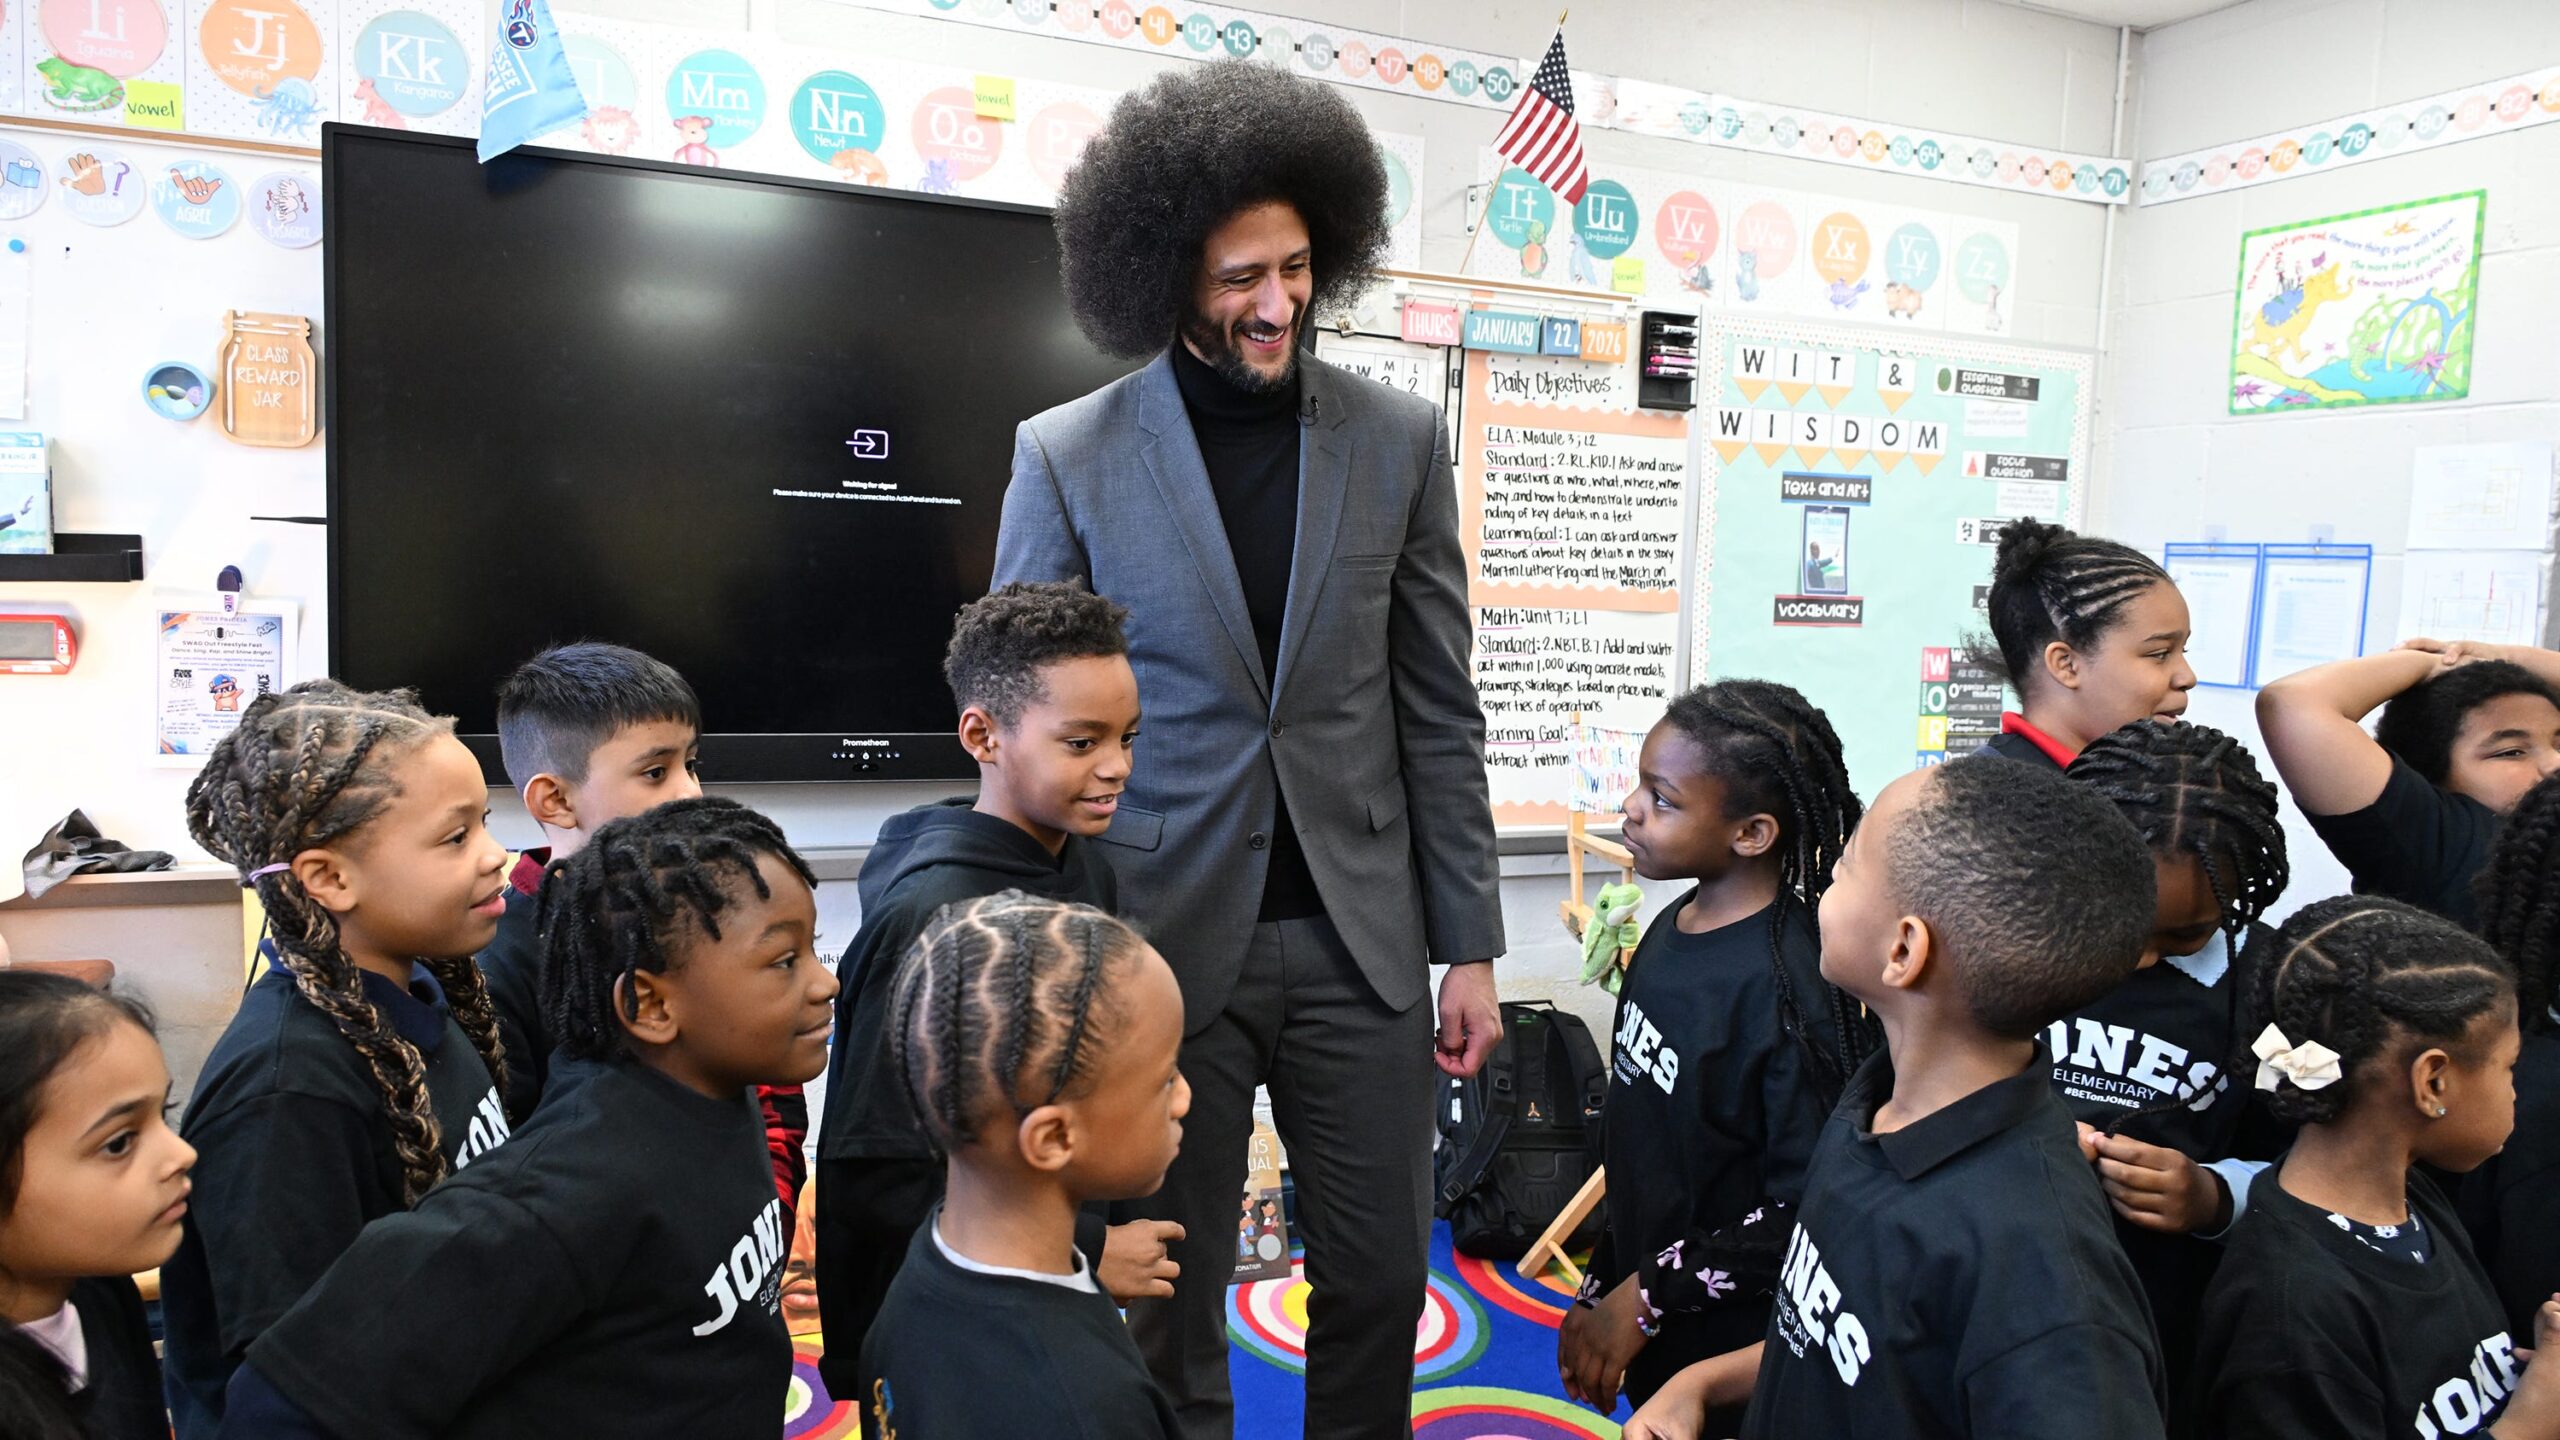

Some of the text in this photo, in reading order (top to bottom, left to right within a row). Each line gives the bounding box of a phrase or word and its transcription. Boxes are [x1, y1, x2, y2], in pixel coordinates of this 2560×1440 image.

[1106, 10, 1132, 31] 40
[1148, 16, 1167, 38] 41
[233, 11, 287, 71] Jj
[1187, 22, 1212, 46] 42
[1231, 28, 1251, 49] 43
[378, 33, 441, 84] Kk
[1305, 40, 1330, 63] 45
[1343, 47, 1367, 70] 46
[1379, 55, 1403, 78] 47
[1416, 61, 1440, 84] 48
[1452, 68, 1474, 91] 49
[1486, 73, 1511, 96] 50
[393, 82, 456, 101] Kangaroo
[681, 71, 750, 110] Mm
[127, 101, 176, 118] vowel
[811, 92, 865, 136] Nn
[2500, 92, 2526, 116] 82
[930, 105, 984, 150] Oo
[2420, 114, 2443, 135] 80
[813, 133, 847, 149] Newt
[1893, 142, 1910, 160] 63
[2308, 139, 2330, 162] 77
[2343, 129, 2367, 153] 78
[1920, 146, 1938, 164] 64
[2079, 169, 2096, 187] 70
[2108, 171, 2123, 190] 71
[1503, 182, 1538, 220] Tt
[1586, 193, 1623, 231] Uu
[1670, 205, 1704, 242] Vv
[1824, 224, 1857, 261] Xx
[2364, 241, 2391, 257] things
[2393, 245, 2411, 256] you
[2414, 233, 2430, 248] will
[1898, 234, 1928, 277] Yy
[1964, 247, 1998, 281] Zz
[2350, 253, 2432, 272] The more that you
[2395, 273, 2425, 290] places
[1407, 309, 1621, 356] THURS. JANUARY 22, 2026
[246, 343, 290, 364] CLASS
[235, 365, 301, 387] REWARD
[1742, 347, 1903, 387] WIT &
[1408, 376, 1419, 395] 2
[1491, 370, 1612, 400] Daily Objectives
[251, 390, 284, 409] JAR
[1523, 430, 1564, 445] Module
[1719, 409, 1939, 450] WISDOM
[1619, 456, 1636, 469] Ask
[1637, 457, 1656, 470] and
[1504, 474, 1549, 487] questions
[1818, 482, 1845, 497] and
[1557, 494, 1567, 503] to
[1518, 509, 1527, 519] of
[1532, 508, 1549, 523] key
[1613, 512, 1632, 523] text
[1576, 531, 1597, 542] can
[1532, 548, 1564, 559] about
[1569, 548, 1586, 561] key
[1619, 567, 1651, 579] March
[1604, 639, 1624, 654] Add
[1627, 642, 1645, 655] and
[1477, 658, 1631, 679] act within using concrete
[1577, 680, 1604, 693] based
[1605, 683, 1616, 694] on
[1536, 698, 1603, 716] of operations
[842, 738, 890, 748] Promethean
[1485, 726, 1535, 752] earning
[1485, 751, 1528, 767] ubtract
[2034, 1016, 2229, 1112] ONES
[2052, 1068, 2158, 1102] ELEMENTARY
[1253, 1138, 1269, 1154] IS
[1249, 1157, 1273, 1172] UAL
